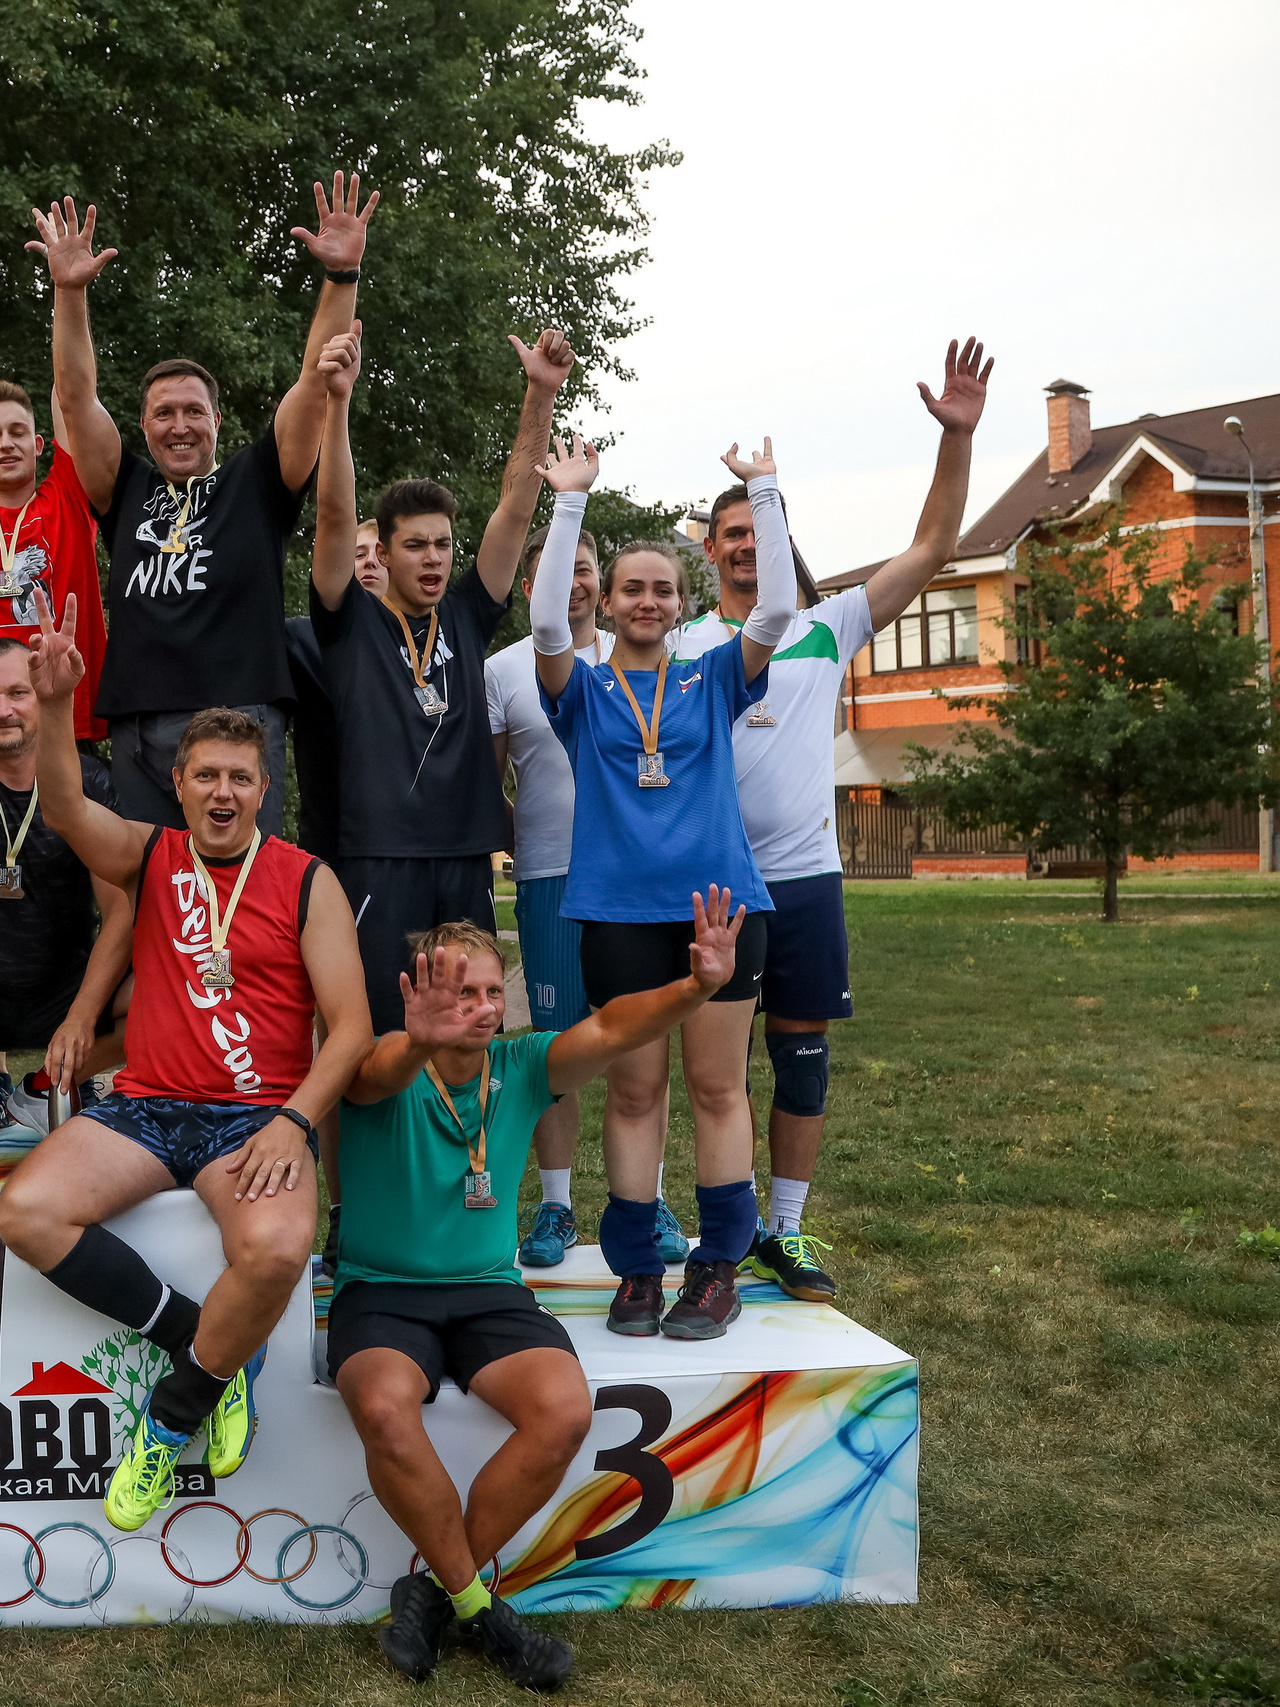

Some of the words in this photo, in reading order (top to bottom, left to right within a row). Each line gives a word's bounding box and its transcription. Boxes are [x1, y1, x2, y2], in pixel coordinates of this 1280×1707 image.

[125, 548, 213, 597] NIKE
[535, 983, 555, 1008] 10
[211, 1011, 262, 1094] 200
[67, 1472, 206, 1494] Мва
[574, 1383, 674, 1560] 3
